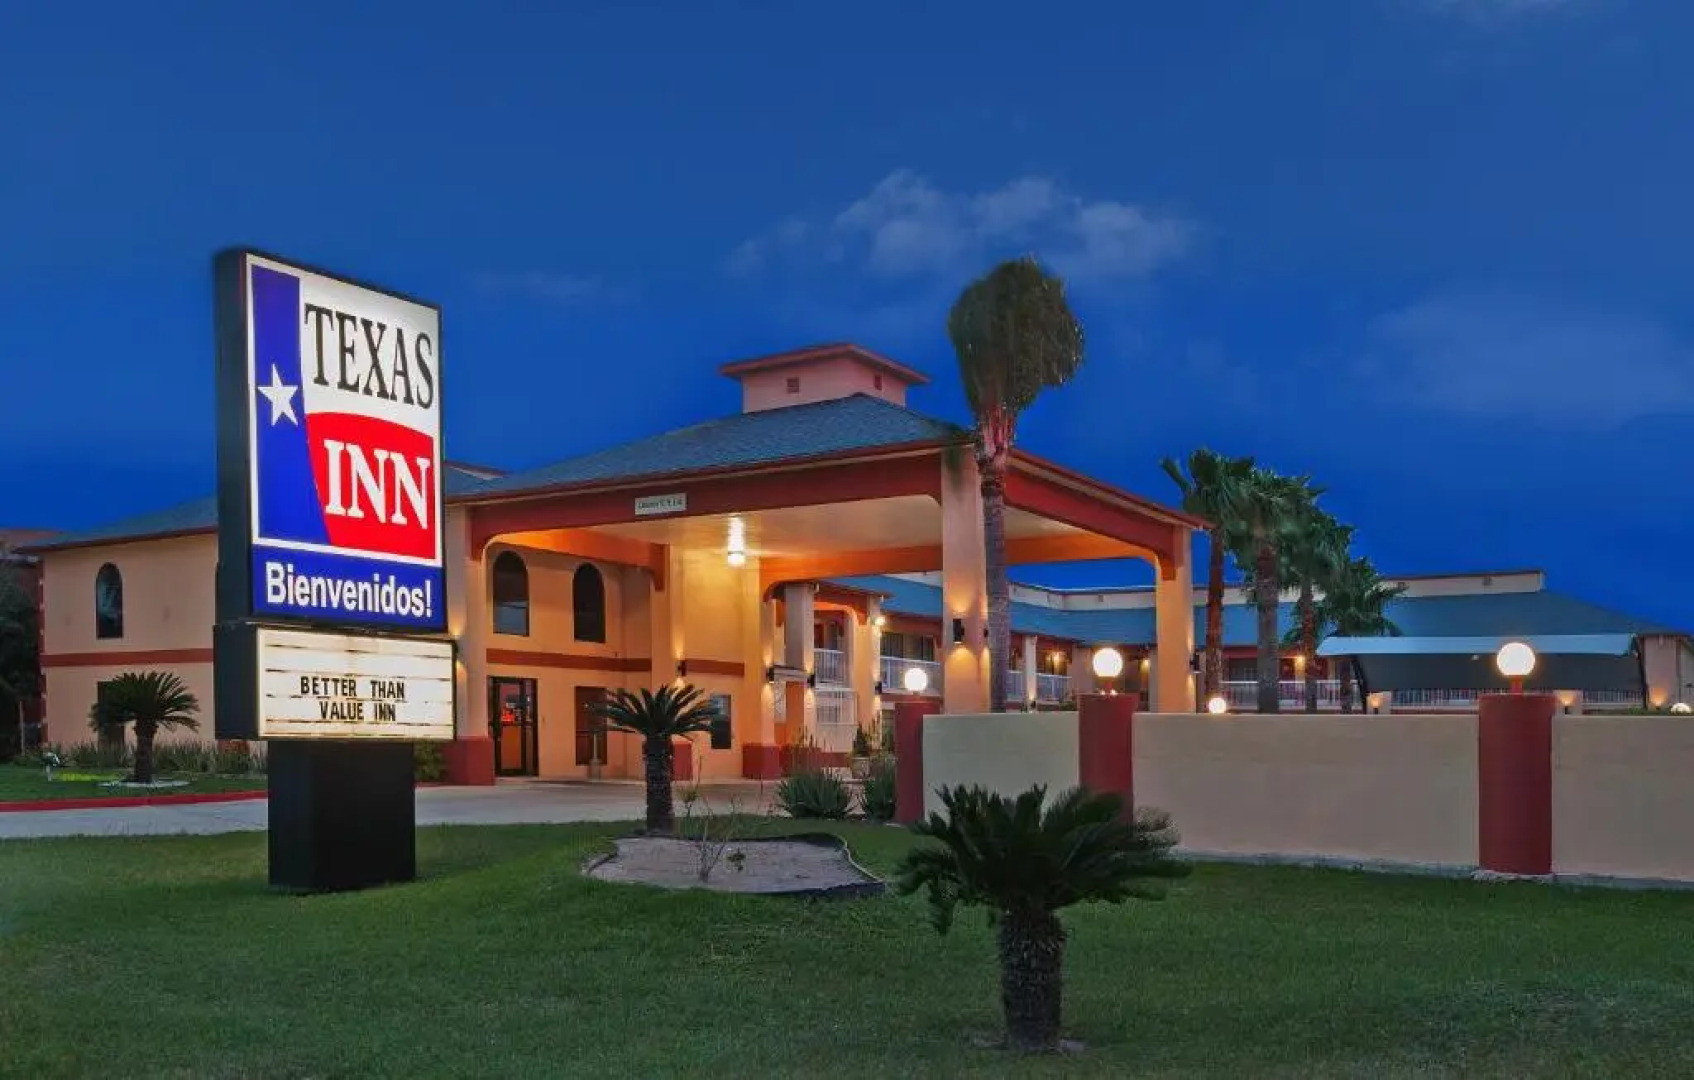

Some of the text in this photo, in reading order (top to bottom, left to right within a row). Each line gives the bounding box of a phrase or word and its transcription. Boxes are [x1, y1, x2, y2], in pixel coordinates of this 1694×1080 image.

[304, 303, 434, 409] TEXAS
[323, 439, 431, 530] INN
[265, 561, 433, 618] Bienvenidos!
[300, 676, 405, 699] BETTER THAN
[319, 701, 396, 722] VALUE INN
